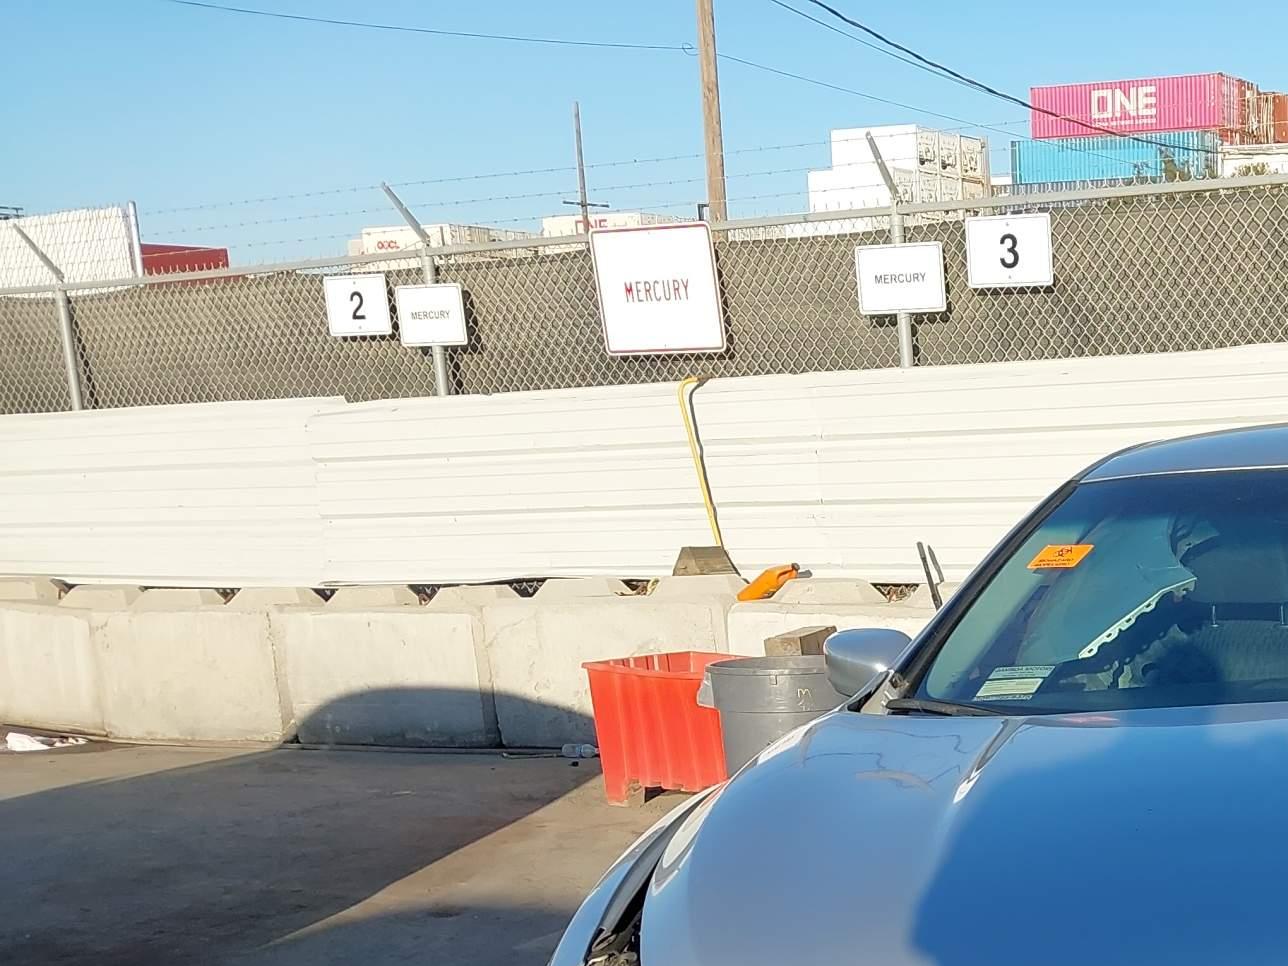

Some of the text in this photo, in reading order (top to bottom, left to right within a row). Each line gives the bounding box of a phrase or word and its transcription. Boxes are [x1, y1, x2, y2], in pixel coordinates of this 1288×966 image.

[1090, 85, 1157, 119] ONE
[999, 232, 1020, 269] 3
[623, 278, 689, 303] MERCURY
[873, 272, 926, 285] MERCURY
[349, 291, 366, 320] 2
[410, 309, 451, 321] MERCURY
